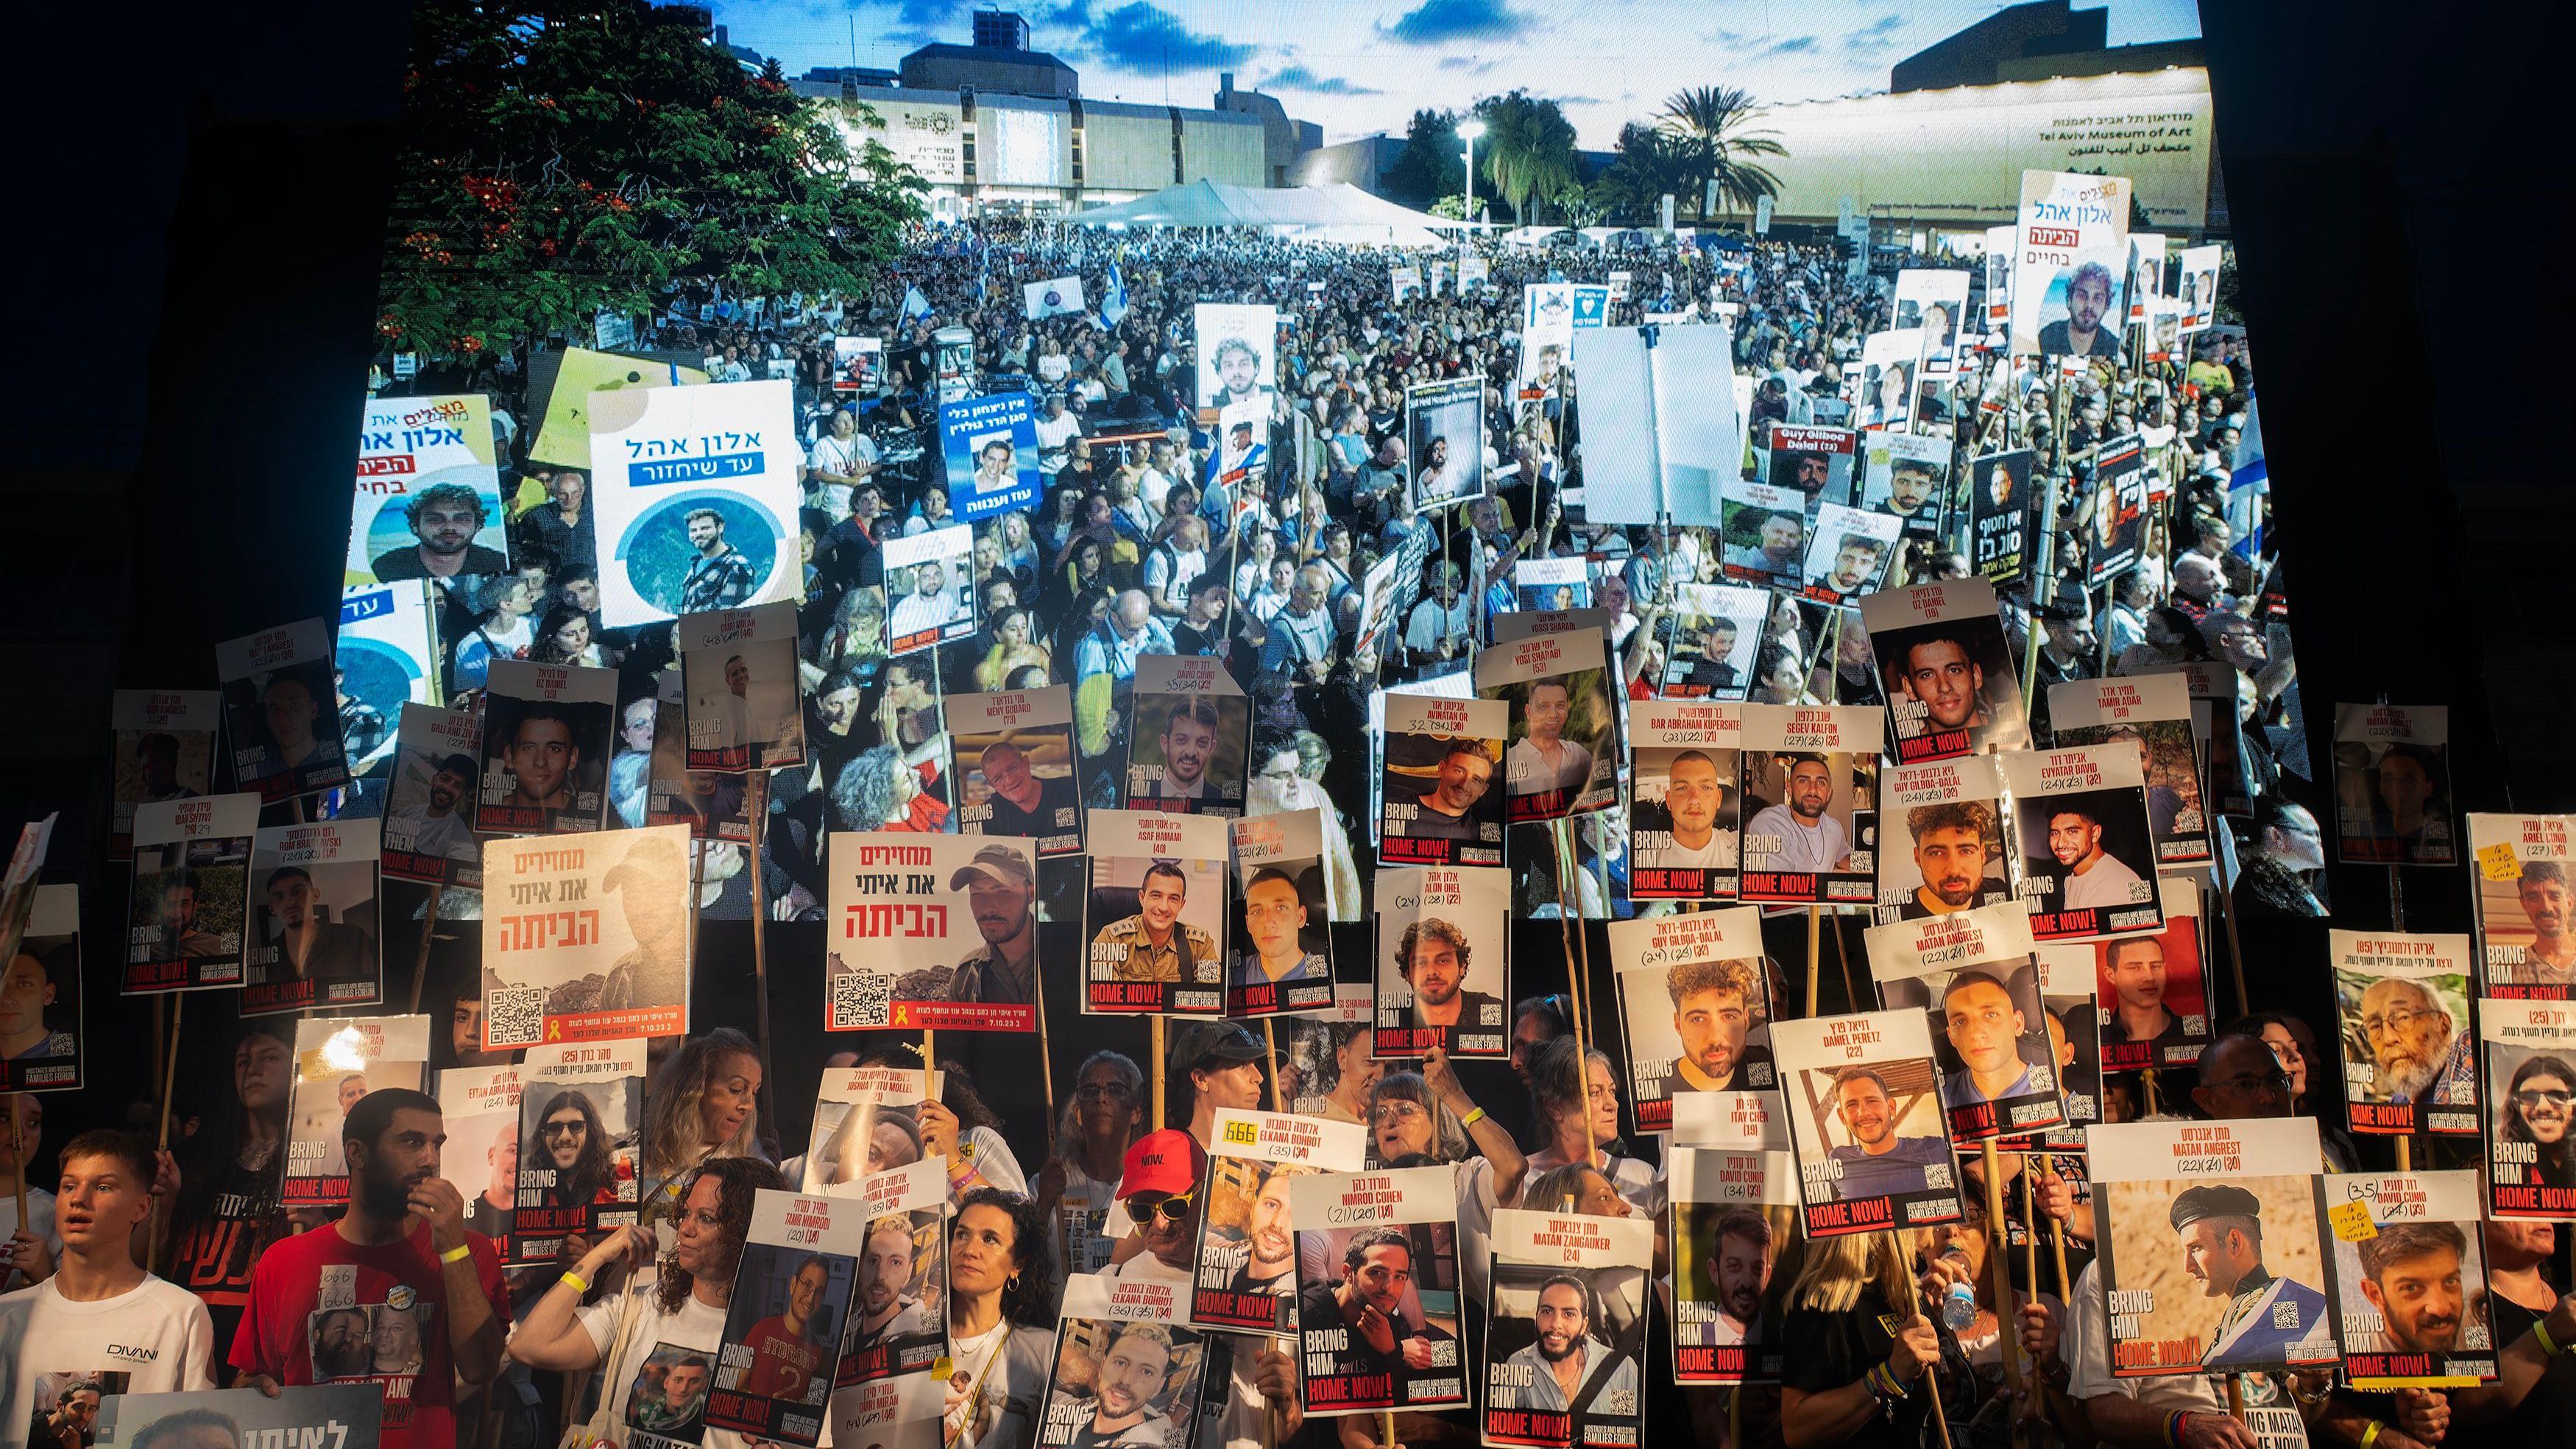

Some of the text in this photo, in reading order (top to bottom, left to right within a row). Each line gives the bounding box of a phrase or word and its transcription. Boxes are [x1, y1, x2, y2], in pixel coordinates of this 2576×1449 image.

[2039, 132, 2054, 141] Tel
[2089, 130, 2145, 139] Museum
[2149, 127, 2164, 137] of
[2168, 127, 2191, 137] Art
[2035, 200, 2070, 222] אהל
[2077, 206, 2112, 227] אלון
[2030, 229, 2078, 245] הביתה
[2027, 251, 2070, 266] בחיים
[948, 399, 1025, 419] אין ניצחון בלי
[950, 413, 1027, 436] סגן הדר גולדין
[402, 427, 464, 453] אלון
[626, 431, 761, 458] אלון אהל
[641, 455, 754, 481] עד שיחזור
[966, 489, 1031, 513] עוז וענווה
[1914, 597, 1946, 610] OZ DANIEL
[1515, 650, 1561, 665] YOSI SHARABI
[1532, 662, 1546, 674] (53)
[537, 679, 567, 690] OZ DANIEL
[987, 704, 1031, 717] MENY GODARD
[2098, 696, 2142, 708] TAMIR ADAR
[1427, 710, 1468, 721] AVINATAN OR
[1652, 719, 1702, 730] BAR ABRAHAM
[1786, 723, 1837, 734] SEGEV KALFON
[2042, 762, 2098, 778] EVYATAR DAVID
[1138, 832, 1181, 842] ASAF HAMAMI
[2522, 833, 2567, 844] ARIEL CUNIO
[860, 846, 931, 866] מחזירים
[1153, 843, 1166, 854] (40)
[514, 849, 584, 874] מחזירים
[509, 878, 587, 905] את איתי
[856, 875, 935, 895] את איתי
[1425, 883, 1460, 893] ALON OHEL
[1395, 895, 1420, 910] (24)
[846, 904, 947, 938] הביתה
[132, 926, 162, 945] BRING
[500, 909, 599, 952] הביתה
[1652, 930, 1723, 949] GUY GILBOA-DALAL
[2357, 940, 2372, 954] (85)
[130, 944, 151, 963] HIM
[1091, 942, 1128, 962] BRING
[2414, 943, 2435, 954] אריה
[1091, 963, 1114, 981] HIM
[1090, 983, 1162, 1004] HOME NOW!
[1175, 997, 1220, 1007] FAMILIES FORUM
[1379, 991, 1412, 1009] BRING
[1379, 1010, 1398, 1028] HIM
[1378, 1026, 1446, 1048] HOME NOW!
[1459, 1041, 1503, 1050] FAMILIES FORUM
[1823, 1031, 1881, 1048] DANIEL PERETZ
[562, 1048, 611, 1063] סהר ברוך (25)
[1846, 1046, 1863, 1059] (22)
[1731, 1110, 1769, 1122] ITAY CHEN
[1744, 1124, 1758, 1136] (19)
[1259, 1132, 1321, 1147] ELKANA BOHBOT
[2173, 1142, 2241, 1157] MATAN ANGREST
[1141, 1154, 1164, 1166] NOW.
[1342, 1190, 1403, 1205] NIMROD COHEN
[2377, 1191, 2427, 1203] DAVID CUNIO
[784, 1213, 830, 1230] TAMIR NIMRODI
[1534, 1233, 1610, 1250] MATAN ZANGAUKER
[1563, 1249, 1580, 1263] (24)
[2108, 1289, 2154, 1314] BRING
[2110, 1314, 2140, 1339] HIM
[1306, 1328, 1348, 1352] BRING
[107, 1345, 160, 1361] DIVANI
[2115, 1336, 2202, 1366] HOME NOW!
[1306, 1353, 1334, 1376] HIM
[1490, 1363, 1533, 1387] BRING
[1308, 1372, 1393, 1401] HOME NOW!
[1490, 1386, 1517, 1409] HIM
[1489, 1411, 1571, 1439] HOME NOW!
